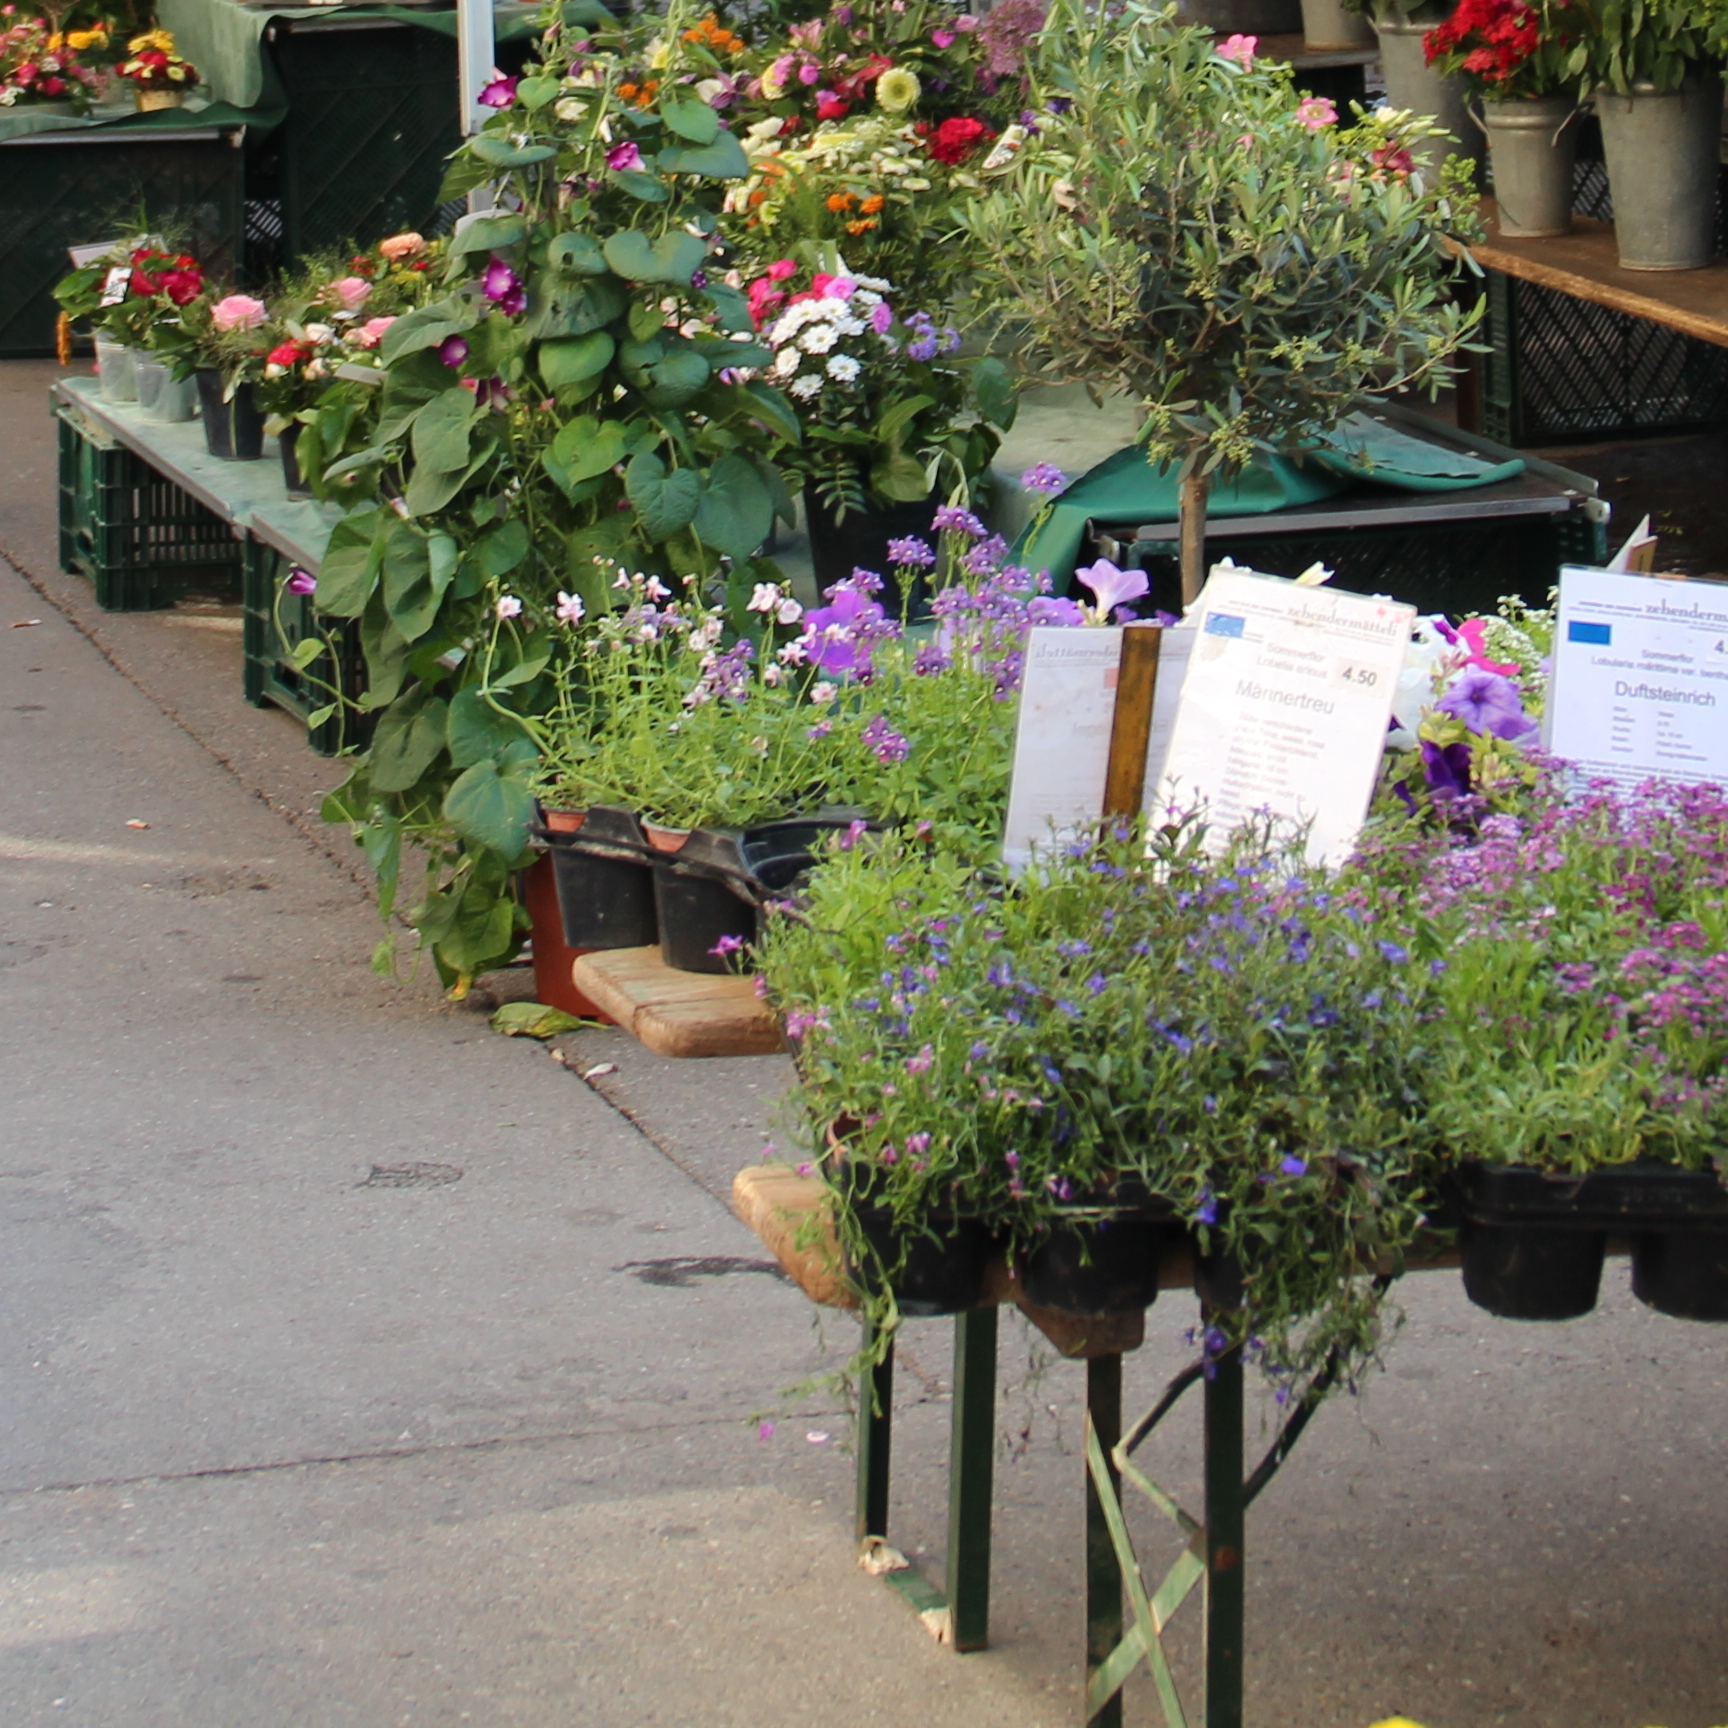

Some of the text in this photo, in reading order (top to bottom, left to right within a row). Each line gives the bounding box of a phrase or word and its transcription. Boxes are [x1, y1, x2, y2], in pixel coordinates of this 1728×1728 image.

[1341, 666, 1378, 687] 4.50
[1234, 678, 1335, 715] Männertreu
[1614, 680, 1716, 707] Duftsteinrich
